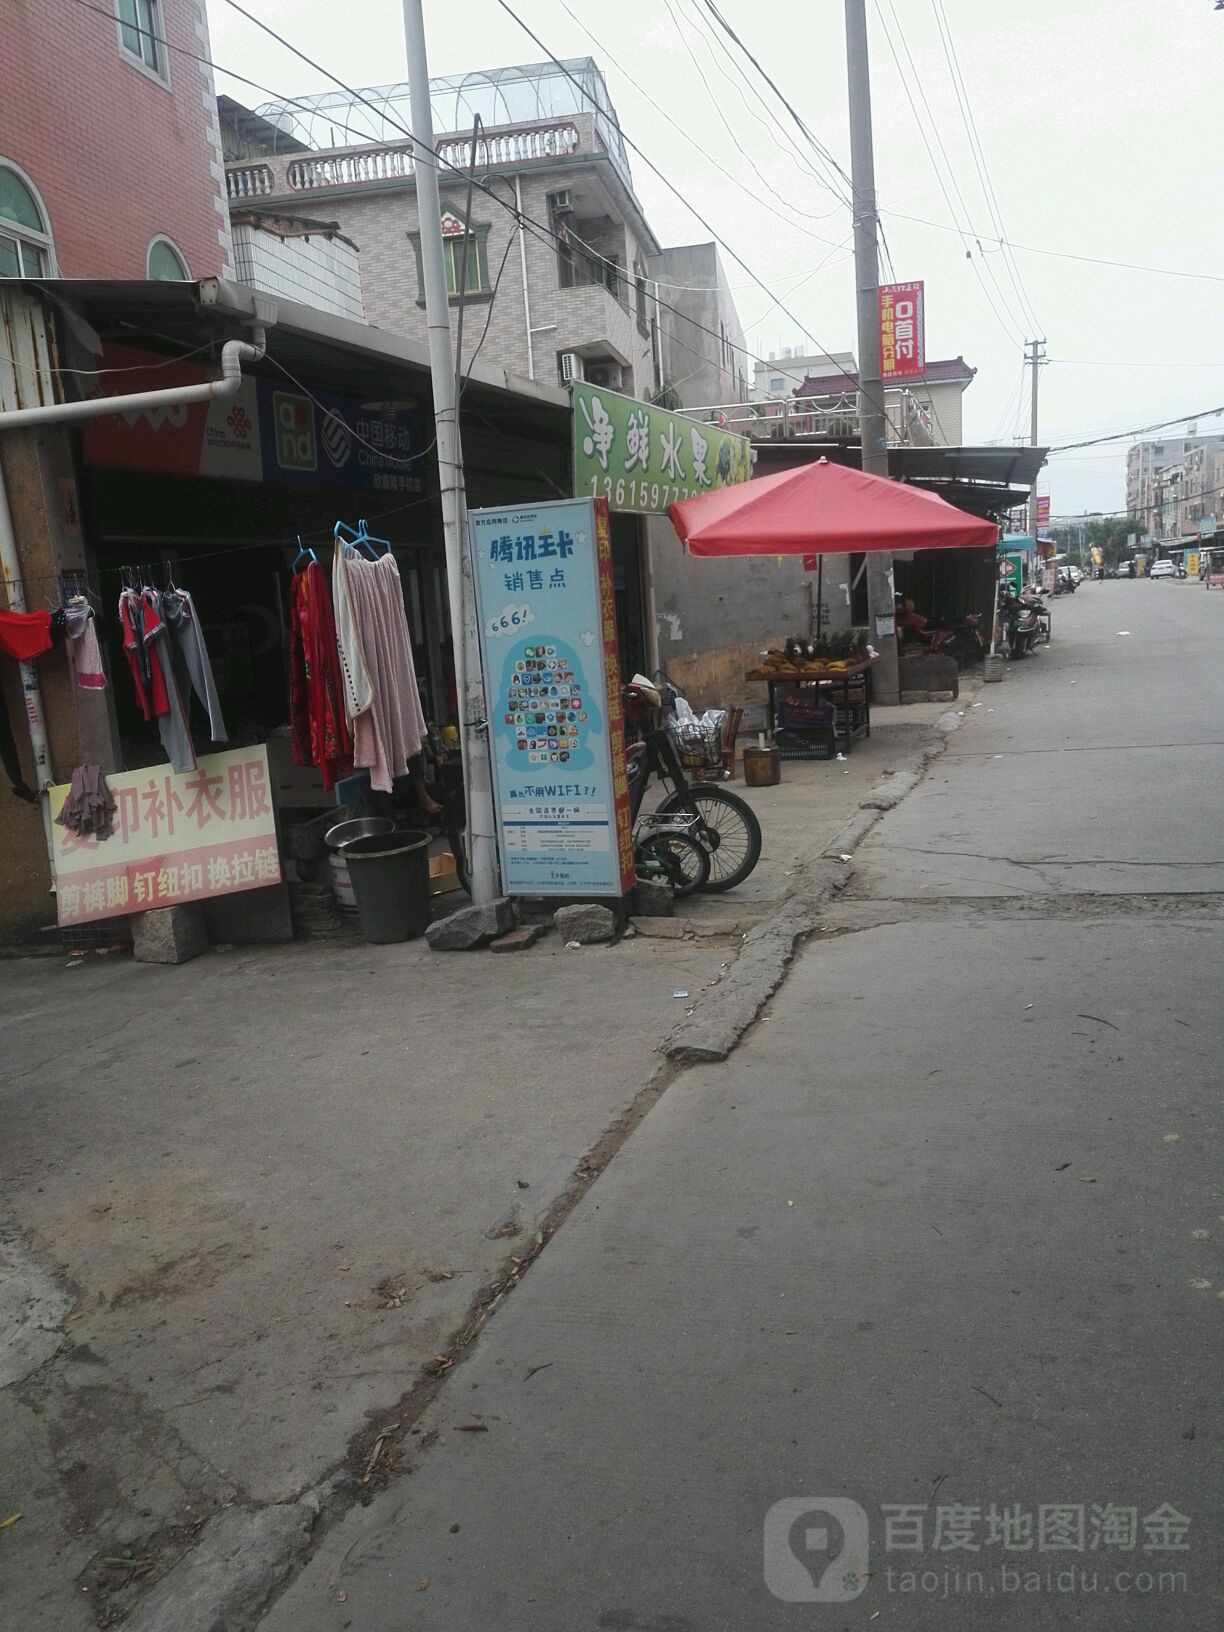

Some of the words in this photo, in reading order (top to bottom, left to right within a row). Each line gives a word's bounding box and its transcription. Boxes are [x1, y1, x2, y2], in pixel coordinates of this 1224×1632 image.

[207, 427, 225, 438] China
[356, 418, 410, 452] 中国移动
[358, 448, 384, 469] China
[591, 475, 706, 509] 136159777
[490, 530, 574, 562] 腾讯王卡
[504, 568, 566, 592] 销售点
[491, 610, 527, 632] 666!
[59, 759, 271, 857] 印补衣服
[60, 875, 129, 918] 剪裤脚
[134, 863, 204, 902] 钉纽扣
[208, 847, 279, 890] 换拉链
